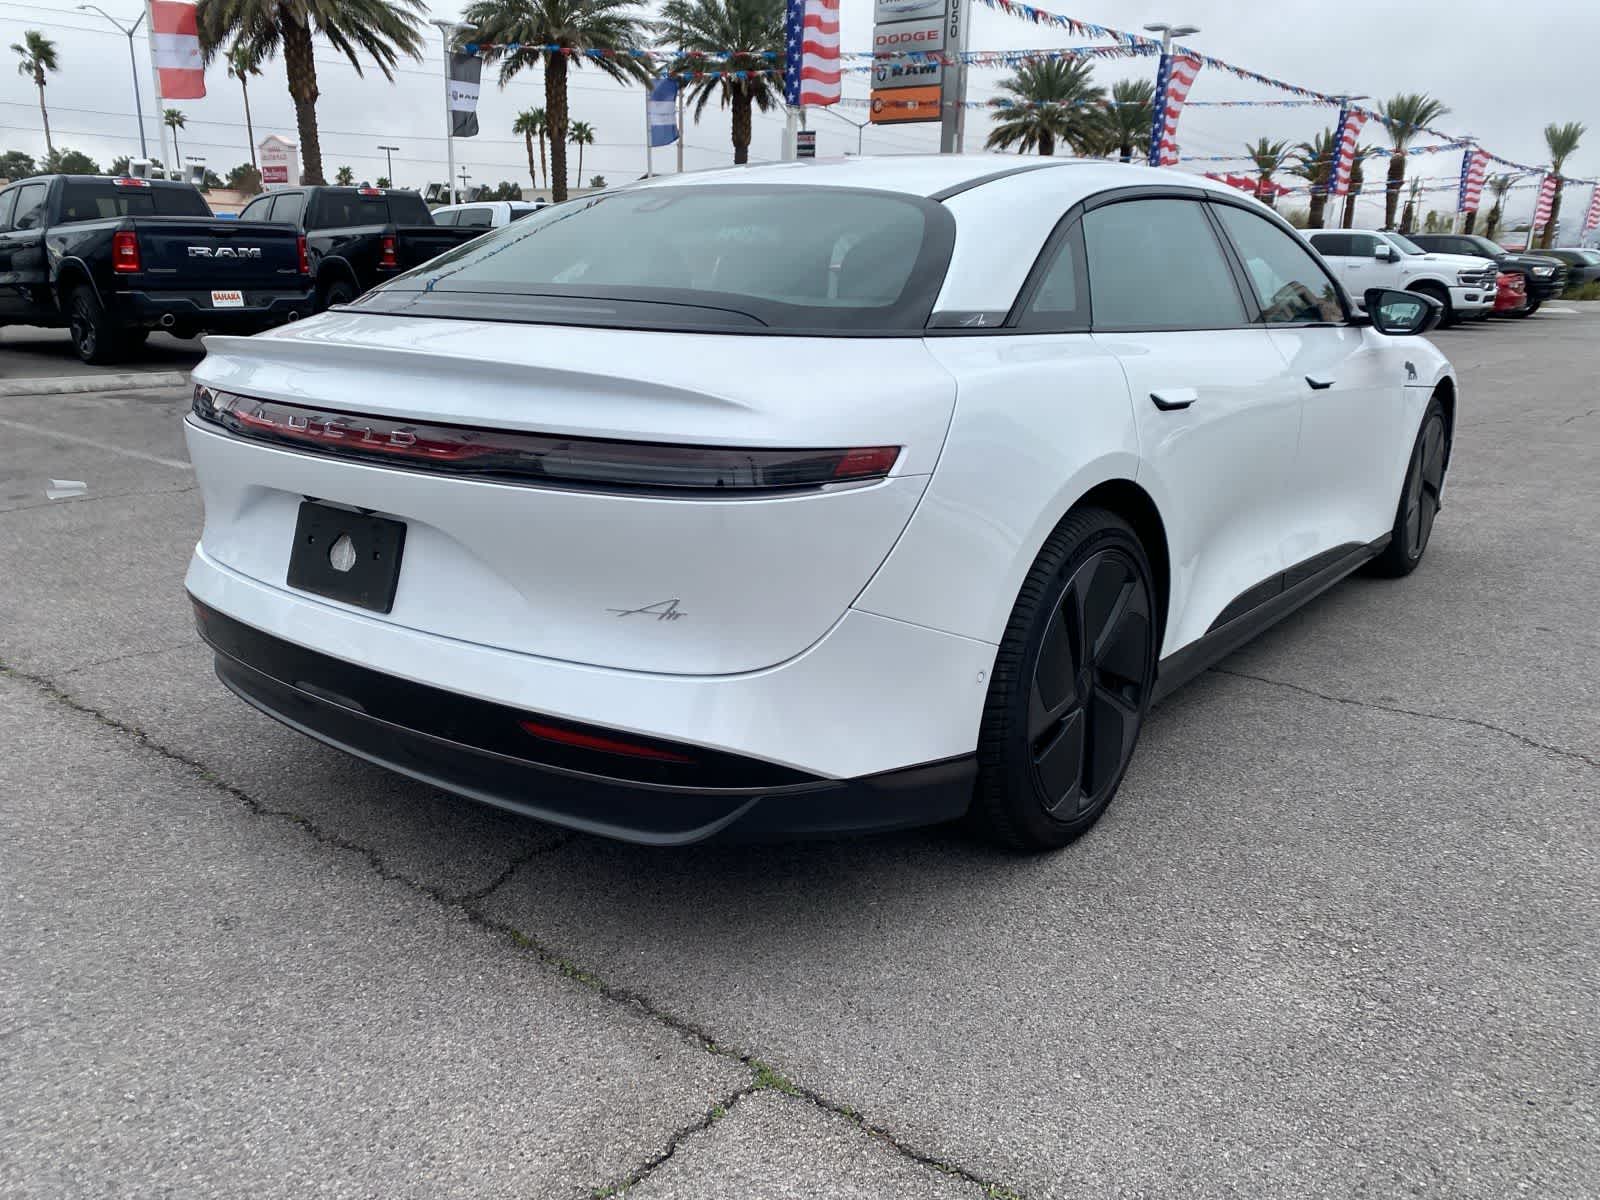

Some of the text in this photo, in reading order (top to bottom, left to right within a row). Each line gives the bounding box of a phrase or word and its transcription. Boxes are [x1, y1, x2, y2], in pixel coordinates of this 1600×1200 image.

[876, 30, 939, 46] DODGE
[891, 63, 937, 77] RAM
[187, 246, 262, 258] RAM
[256, 409, 417, 448] LUCID
[604, 599, 689, 621] Air
